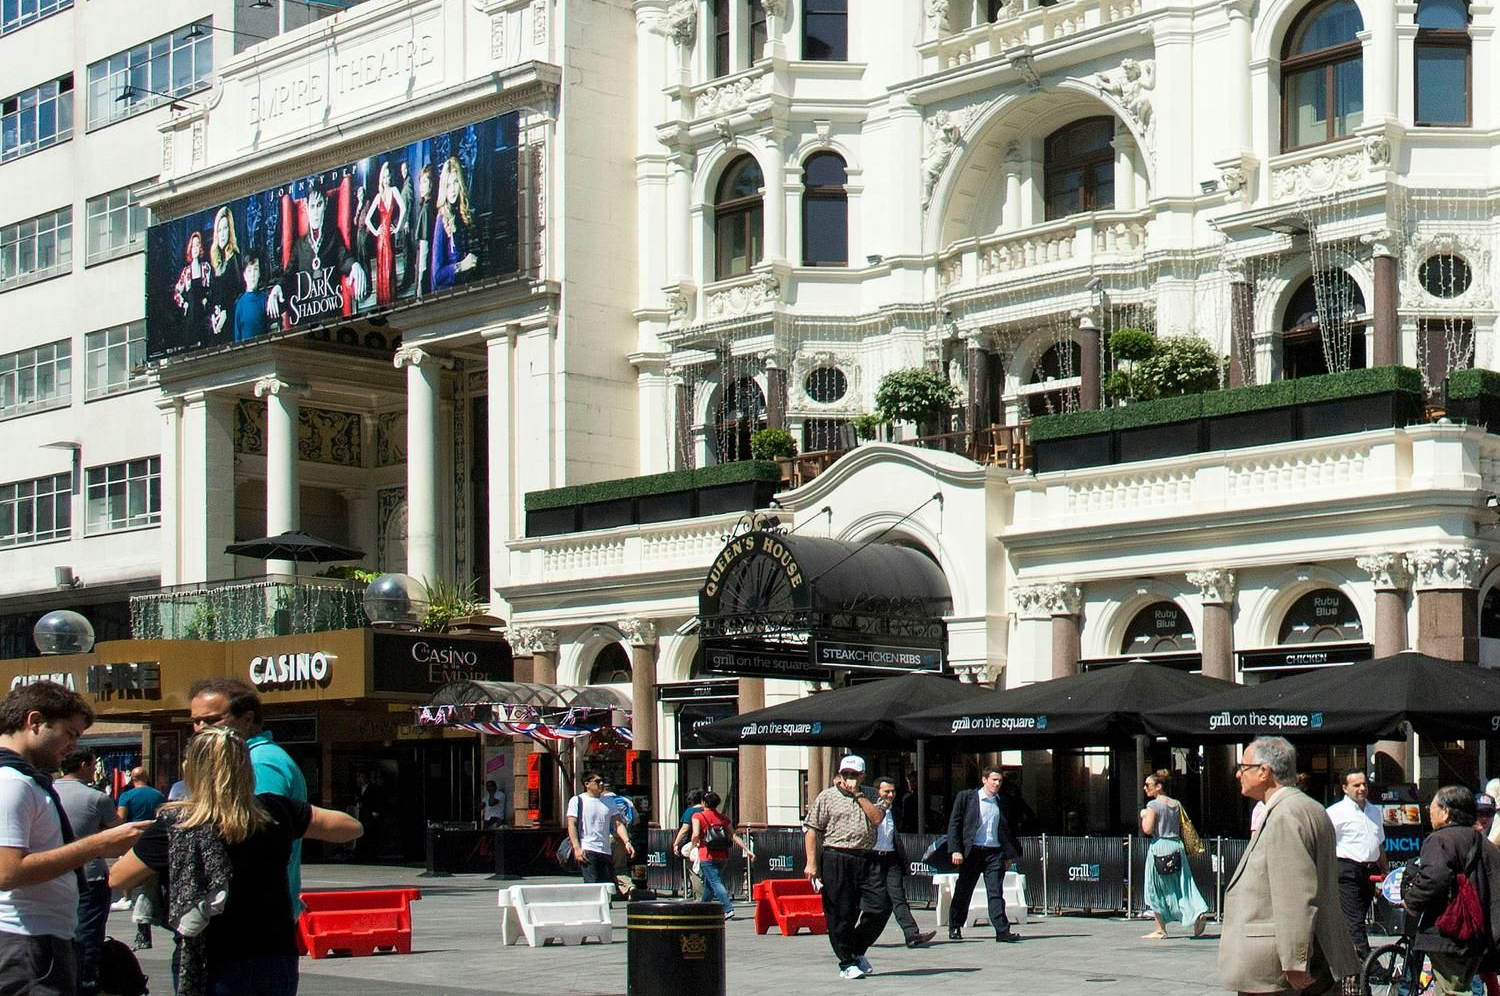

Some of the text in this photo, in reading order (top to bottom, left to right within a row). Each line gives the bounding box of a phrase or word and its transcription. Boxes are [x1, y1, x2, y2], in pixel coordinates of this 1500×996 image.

[250, 35, 434, 126] EMPIRE THEATRE
[269, 175, 325, 202] JOHNNY
[295, 265, 336, 302] DARK
[289, 284, 344, 325] SHADOWS
[706, 536, 803, 597] QUEEN'S HOUSE
[1314, 597, 1339, 607] Ruby
[1154, 610, 1178, 620] Ruby
[1316, 607, 1338, 617] Blue
[1156, 619, 1176, 629] Blue
[712, 654, 809, 671] grill on the square
[1286, 653, 1328, 664] CHICKEN
[249, 651, 328, 685] CASINO
[10, 672, 75, 692] CINMA
[951, 716, 1035, 733] grill on the square
[1209, 712, 1308, 730] grill on the square
[740, 722, 811, 738] grill on the square
[1381, 791, 1394, 801] grill
[1384, 837, 1421, 852] UNCH
[647, 852, 661, 867] grill
[768, 855, 786, 871] grill
[1068, 863, 1090, 881] grill
